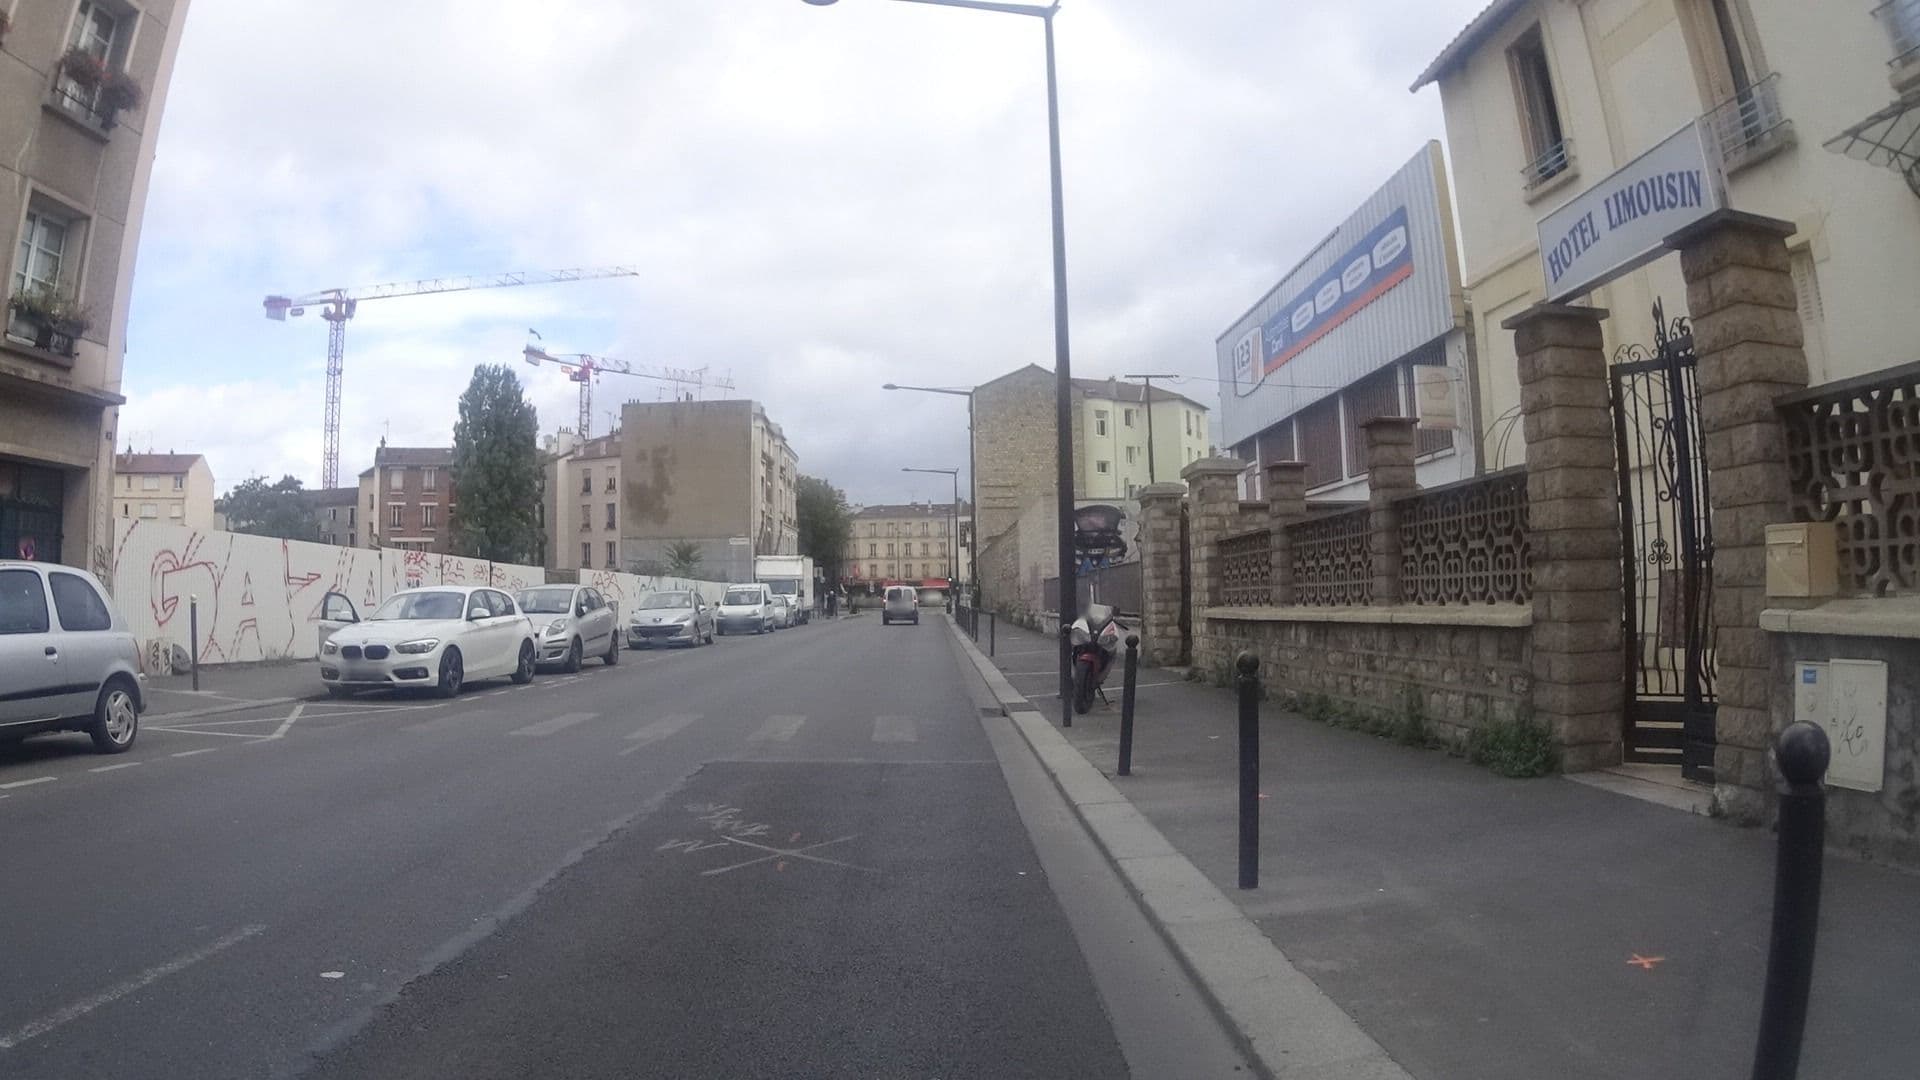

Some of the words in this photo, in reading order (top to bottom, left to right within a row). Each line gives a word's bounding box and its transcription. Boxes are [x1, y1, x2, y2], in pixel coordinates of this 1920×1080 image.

[1547, 211, 1600, 283] HOTEL
[1604, 170, 1702, 231] LIMOUSIN
[1236, 339, 1251, 370] 123
